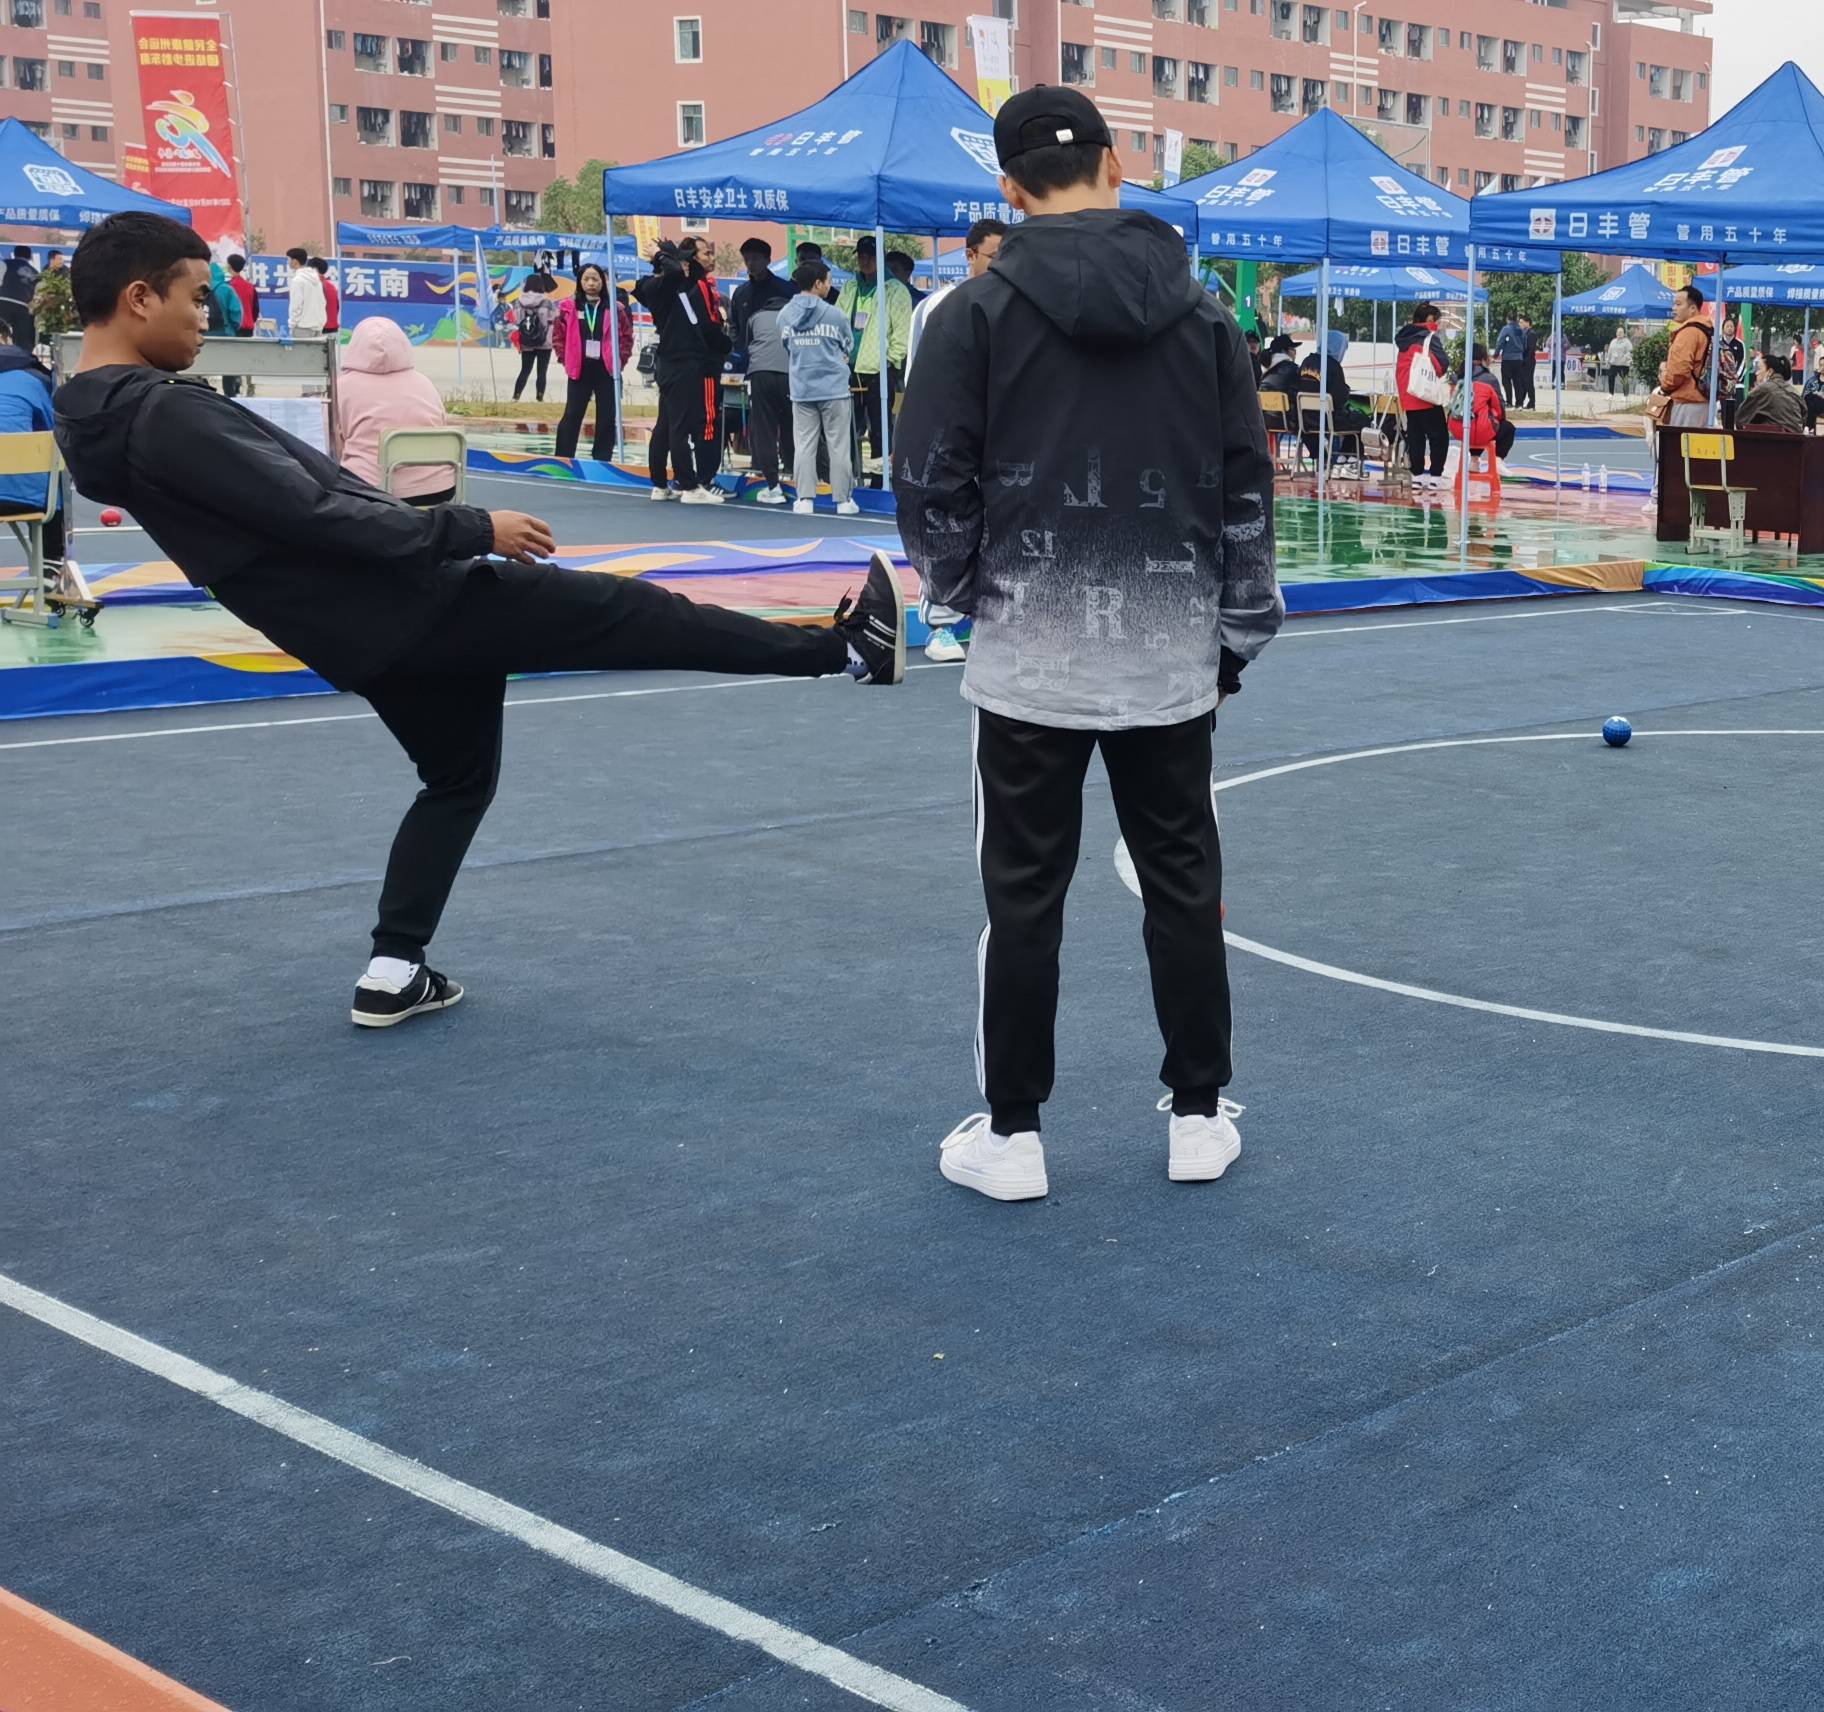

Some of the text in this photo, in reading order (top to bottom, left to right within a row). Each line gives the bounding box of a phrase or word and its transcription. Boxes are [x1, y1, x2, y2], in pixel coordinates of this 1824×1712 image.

[674, 187, 790, 211] 日丰安全卫士 双质保
[1210, 232, 1283, 248] 管用五十年
[1568, 212, 1788, 245] 日丰管 管用五十年
[1397, 234, 1450, 257] 日丰管
